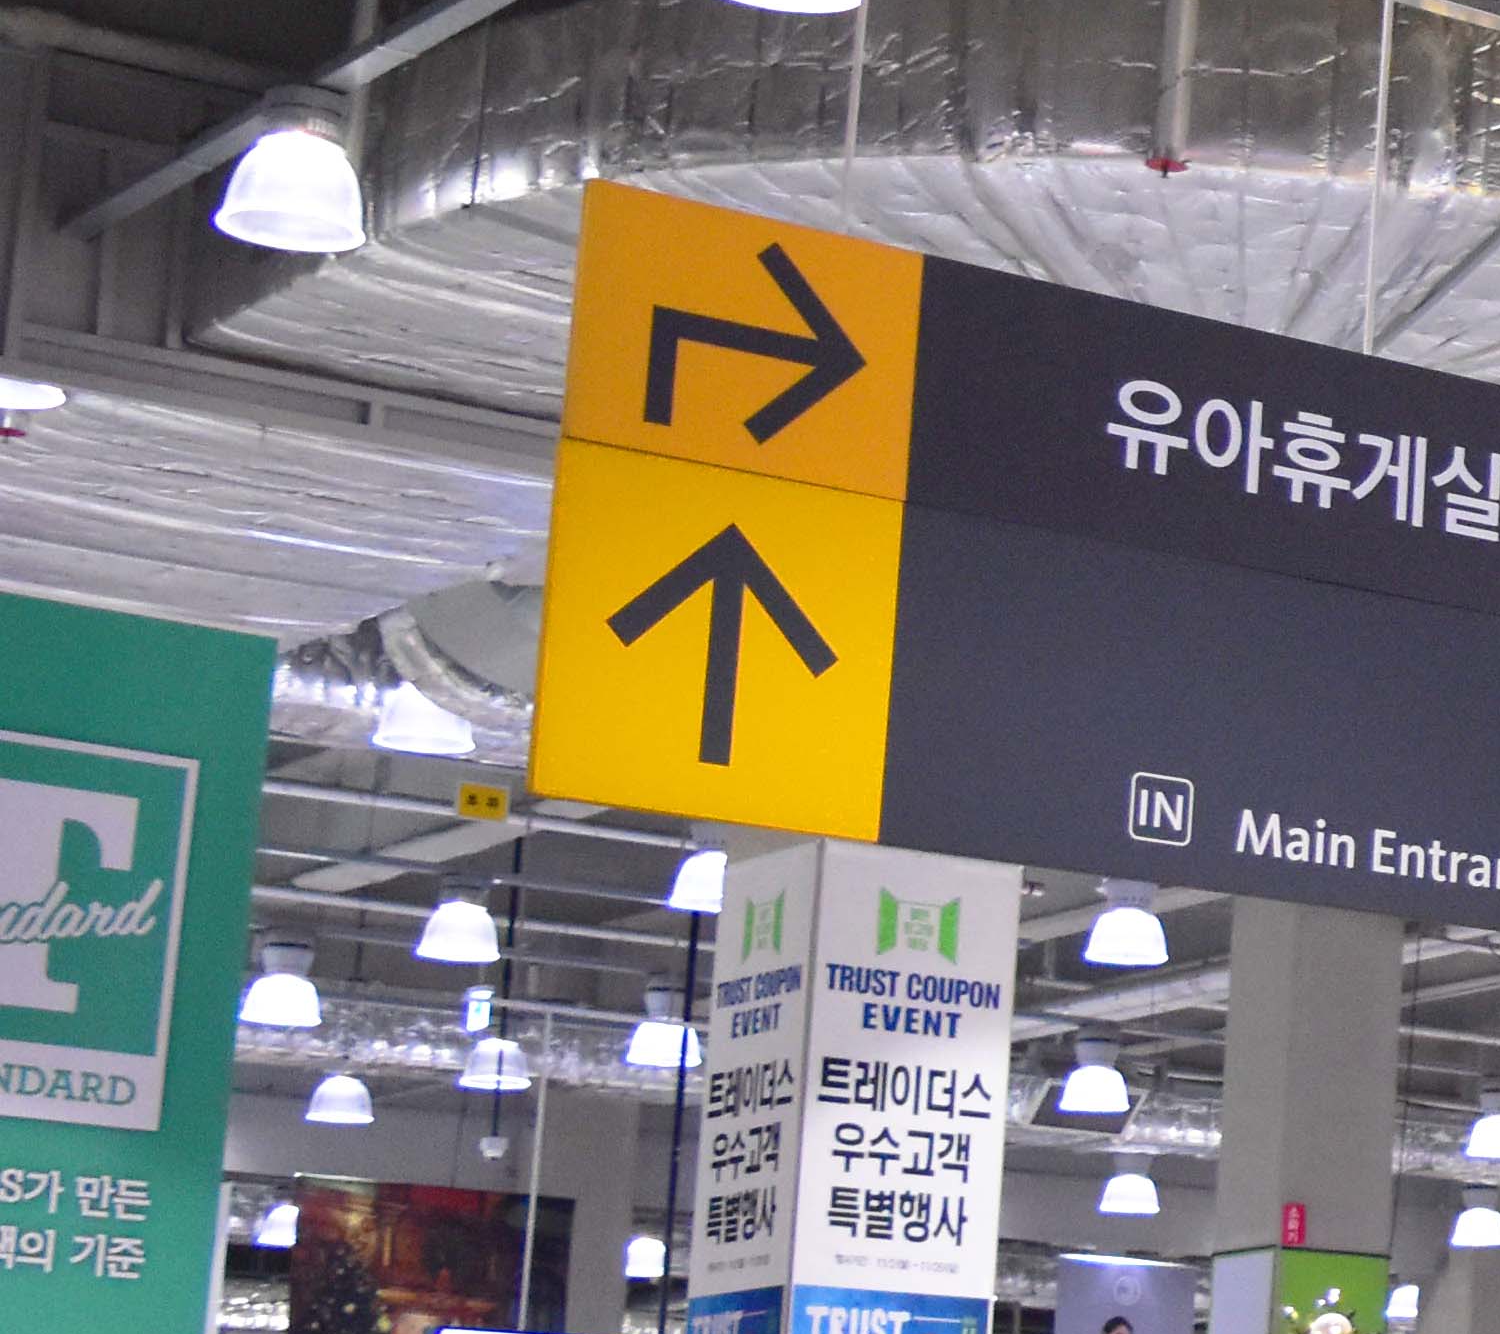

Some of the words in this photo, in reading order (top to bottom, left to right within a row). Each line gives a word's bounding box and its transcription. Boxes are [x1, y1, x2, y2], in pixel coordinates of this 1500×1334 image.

[1137, 787, 1186, 834] IN
[1234, 807, 1357, 870] Main
[826, 963, 901, 998] TRUST
[906, 973, 1001, 1010] COUPON
[731, 1002, 782, 1039] EVENT
[862, 1002, 962, 1039] EVENT
[707, 1058, 794, 1119] 트레이더스
[817, 1056, 992, 1120] 트레이더스
[711, 1121, 782, 1183] 우수고객
[831, 1122, 972, 1184] 우수고객
[75, 1175, 152, 1223] 만든
[706, 1186, 776, 1245] 특별행사
[827, 1186, 968, 1247] 특별행사
[69, 1233, 147, 1279] 기준
